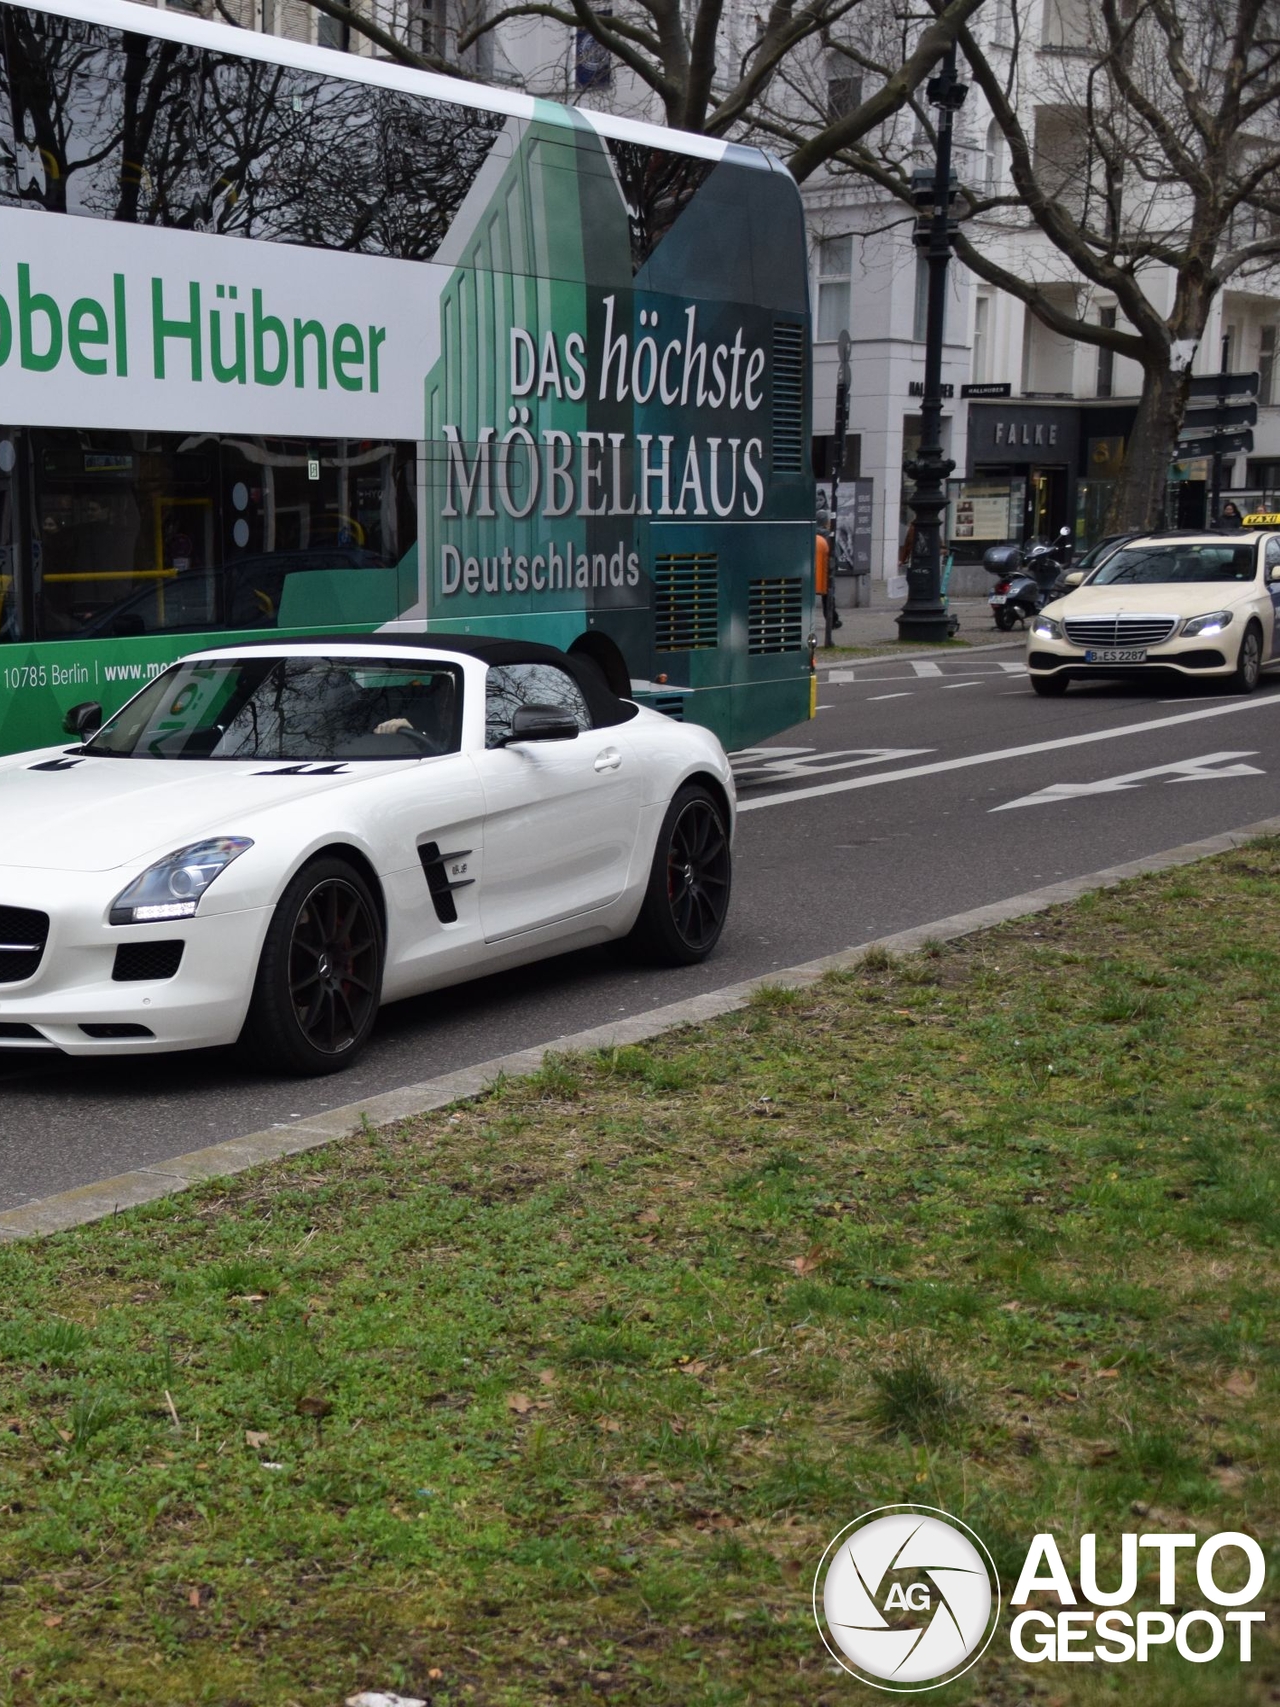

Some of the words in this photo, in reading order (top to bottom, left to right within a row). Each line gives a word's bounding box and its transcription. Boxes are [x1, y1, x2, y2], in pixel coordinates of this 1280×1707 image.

[151, 277, 386, 393] Hübner
[510, 327, 586, 400] DAS
[599, 294, 765, 411] höchste
[995, 422, 1058, 446] FALKE
[441, 405, 765, 518] MÖBELHAUS
[1248, 514, 1277, 524] TAXI
[441, 541, 640, 594] Deutschlands
[1091, 651, 1098, 661] B
[1118, 651, 1144, 661] 2287
[4, 665, 46, 689] 10785
[52, 663, 89, 686] Berlin
